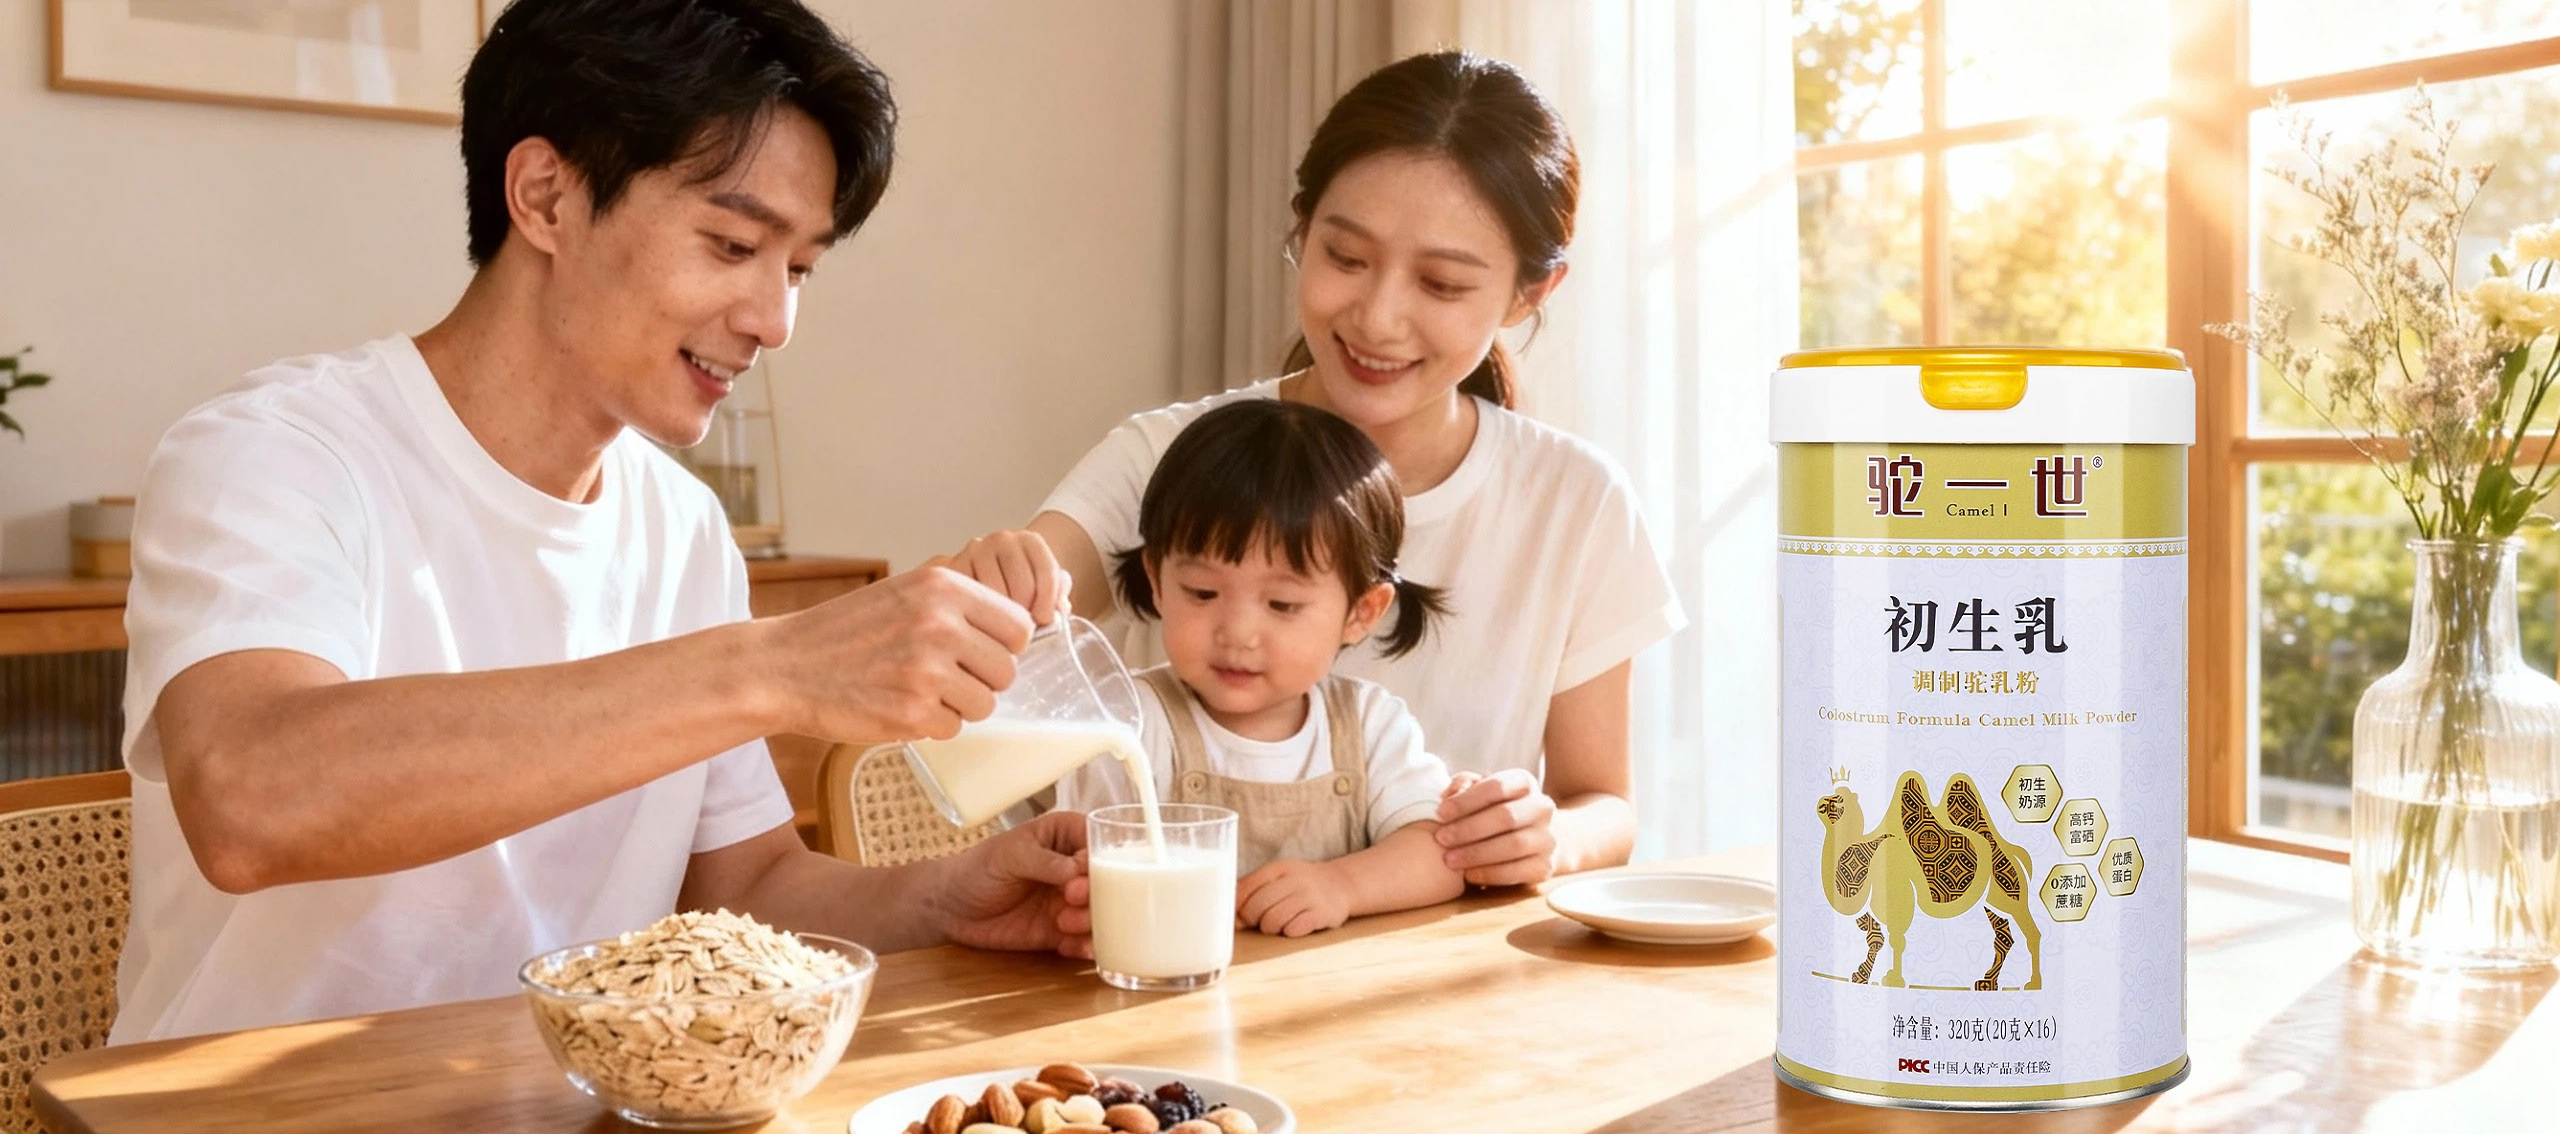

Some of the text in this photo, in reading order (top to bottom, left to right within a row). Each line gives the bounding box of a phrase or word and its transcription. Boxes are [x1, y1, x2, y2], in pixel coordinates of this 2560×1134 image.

[1946, 504, 1995, 517] Camel
[1883, 595, 2069, 655] 初生乳
[1912, 669, 2040, 695] 调制驼乳粉
[1818, 706, 2138, 727] Colostrum Formula Camel Milk Powder
[2018, 777, 2046, 792] 初生
[2018, 794, 2047, 809] 奶源
[2069, 812, 2095, 827] 高钙
[2069, 829, 2095, 844] 富硒
[2112, 851, 2133, 866] 优质
[2050, 875, 2087, 890] 0添加
[2112, 869, 2132, 884] 蛋白
[2055, 894, 2083, 909] 蔗糖
[1898, 1058, 2052, 1075] PICC 中国人保产品责任险
